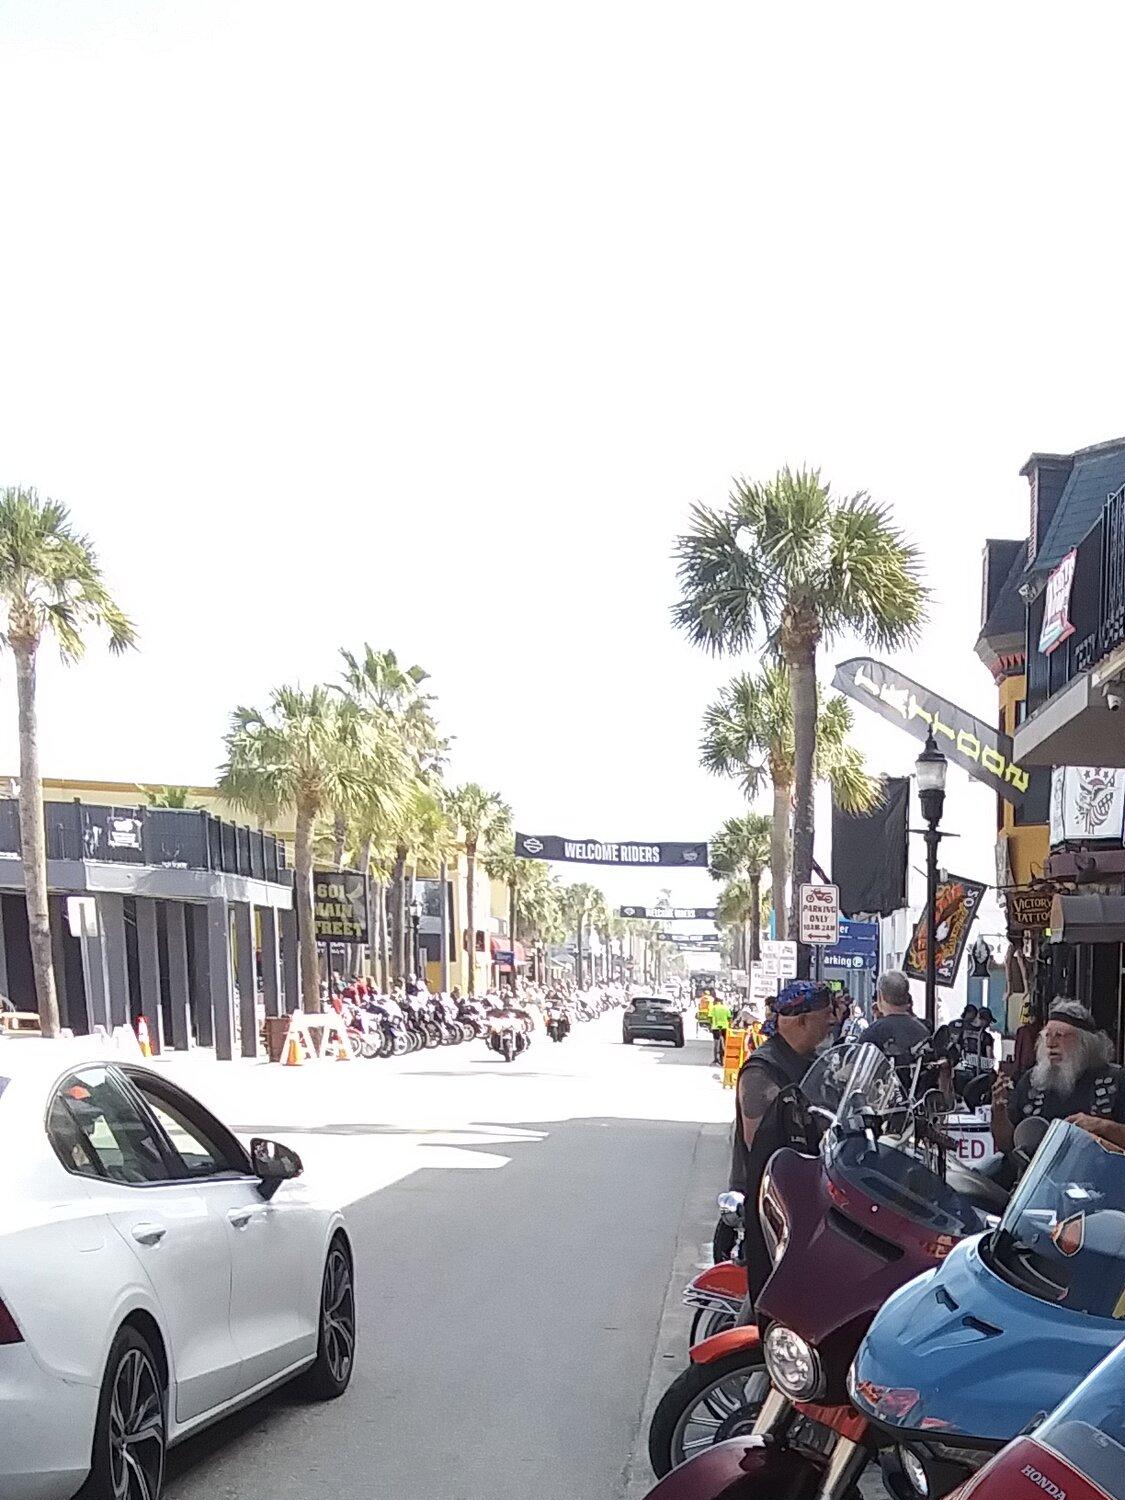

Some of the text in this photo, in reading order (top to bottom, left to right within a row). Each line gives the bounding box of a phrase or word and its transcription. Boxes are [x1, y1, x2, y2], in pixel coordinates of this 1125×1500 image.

[564, 842, 660, 863] WELCOME RIDERS
[317, 883, 345, 899] 601
[803, 905, 836, 913] PARKING
[1013, 898, 1052, 912] VICTORY
[810, 915, 829, 923] ONLY
[1014, 911, 1051, 923] TATTO
[315, 920, 365, 937] TREET
[824, 956, 851, 968] arking
